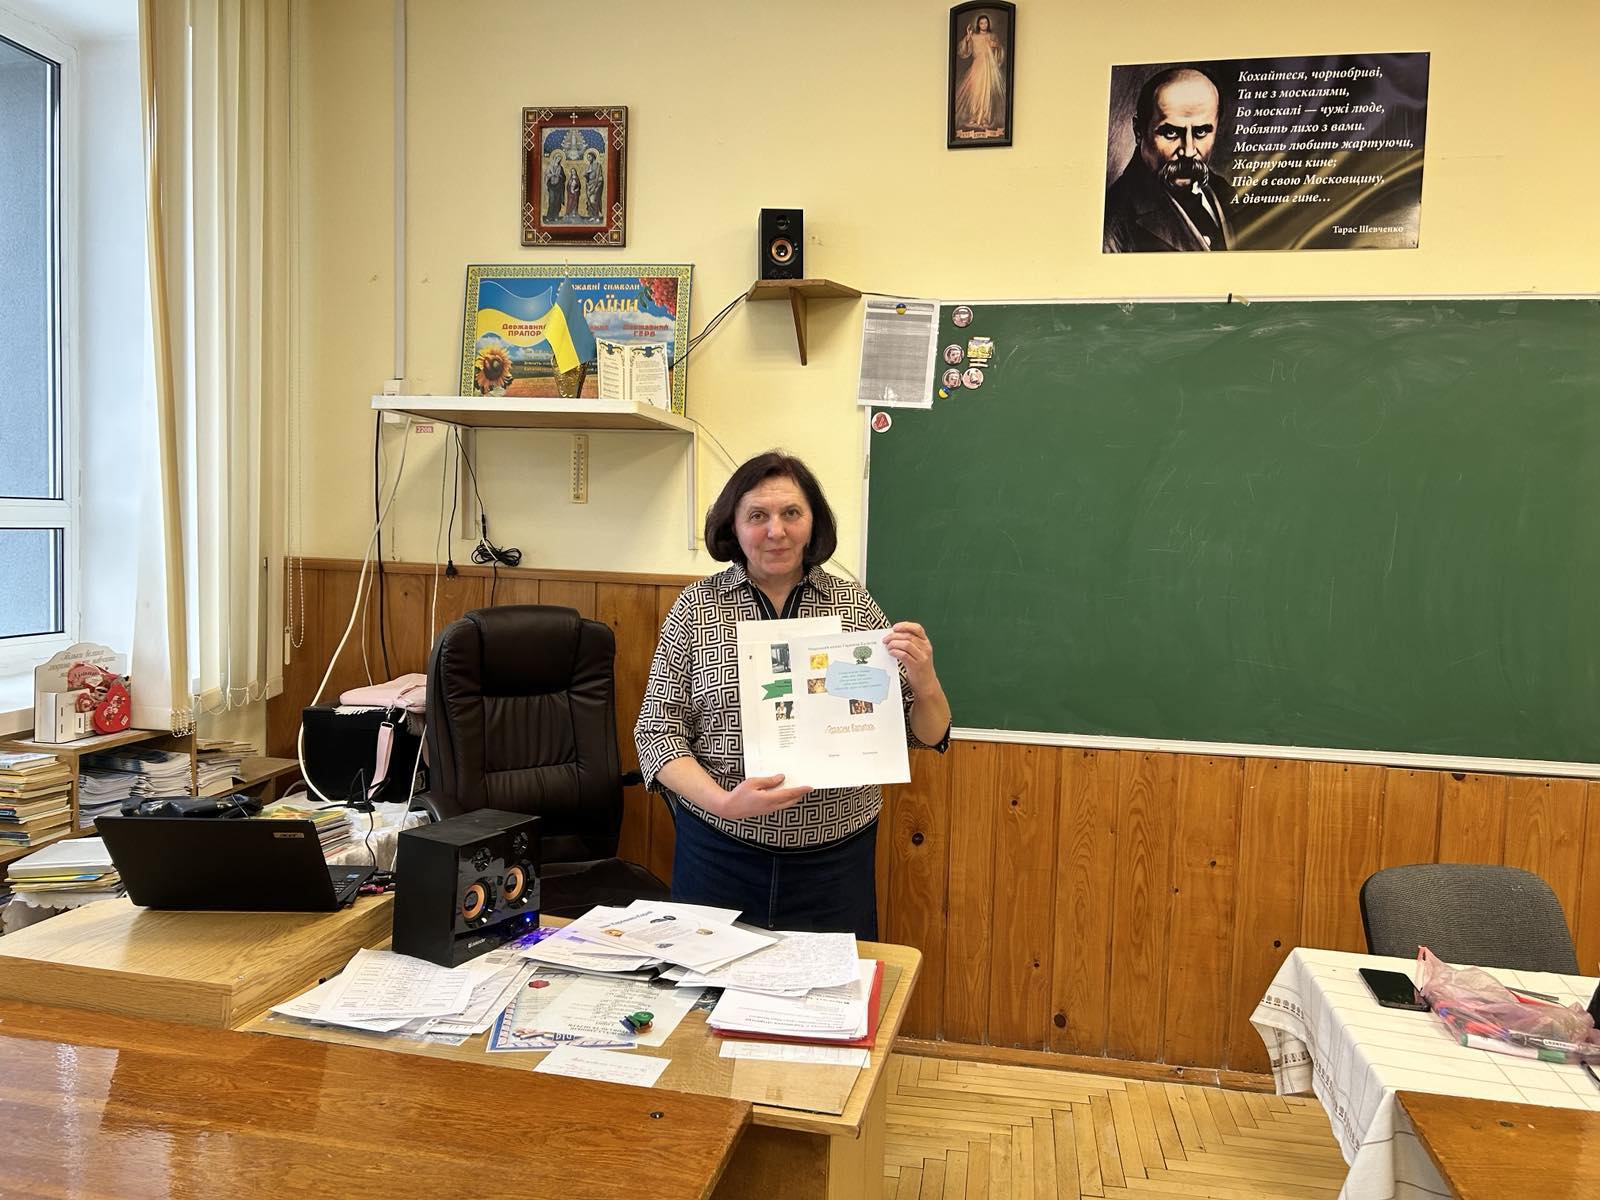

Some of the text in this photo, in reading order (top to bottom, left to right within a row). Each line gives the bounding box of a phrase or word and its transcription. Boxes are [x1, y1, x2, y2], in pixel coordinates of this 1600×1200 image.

[1238, 66, 1383, 82] Кохайтеся, чорнобриві,
[1238, 87, 1350, 100] Та не з москалями,
[1235, 106, 1252, 118] Бо
[1253, 104, 1302, 117] москалі
[1320, 103, 1350, 118] чужі
[1351, 101, 1385, 114] люде,
[1234, 122, 1365, 135] Роблять лихо з вами.
[1233, 138, 1414, 153] Москаль любить жартуючи,
[1232, 158, 1337, 172] Жартуючи кине;
[1232, 174, 1385, 187] Піде в свою Московщину,
[1230, 193, 1240, 204] А
[1243, 192, 1290, 204] дівчина
[1333, 224, 1404, 235] Тарас Шевченко
